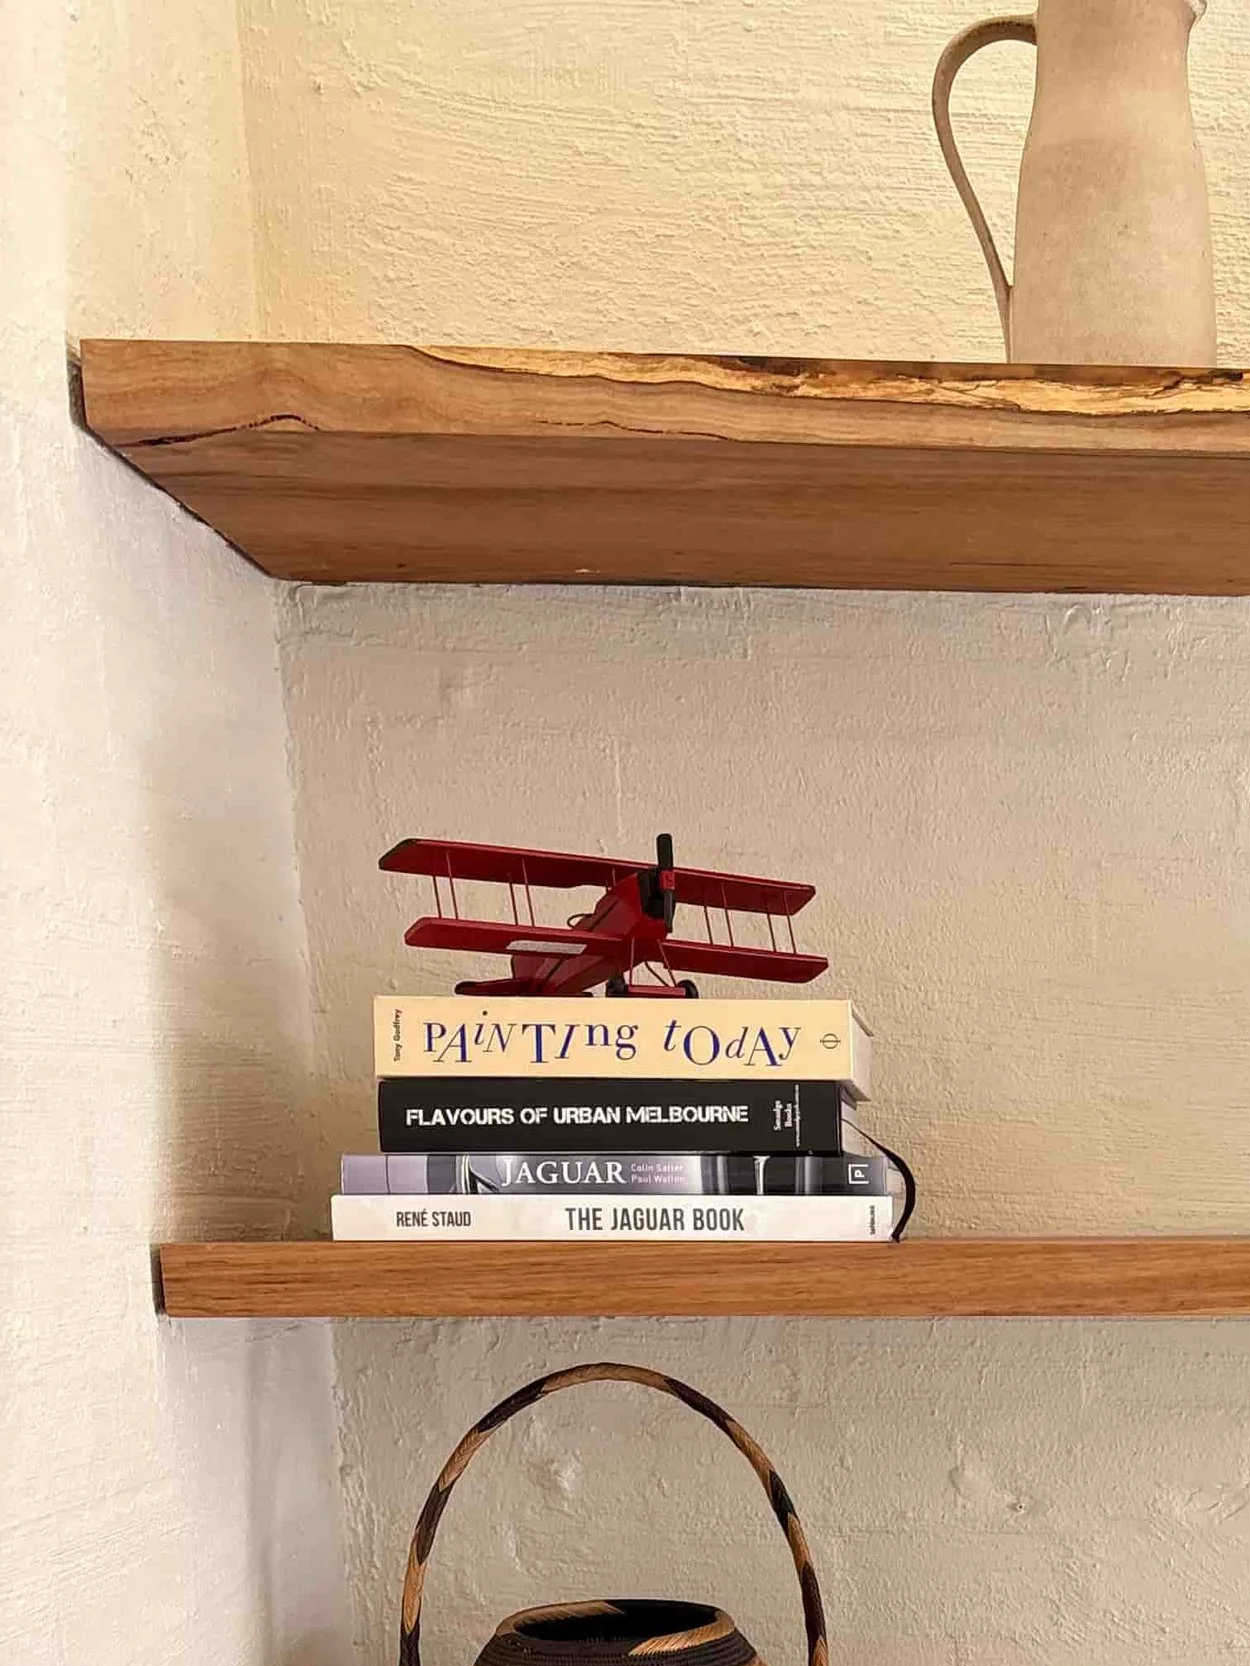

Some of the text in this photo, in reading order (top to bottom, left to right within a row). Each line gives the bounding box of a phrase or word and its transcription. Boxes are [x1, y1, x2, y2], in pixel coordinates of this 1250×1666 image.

[392, 1009, 402, 1061] Tony Godfrey
[406, 1105, 749, 1126] FLAVOURS OF URBAN MELBOURNE
[501, 1156, 627, 1187] JAGUAR
[630, 1163, 654, 1173] Colin
[630, 1174, 652, 1184] Paul
[396, 1208, 471, 1228] RENÉ STAUD
[565, 1207, 745, 1231] THE JAGUAR BOOK
